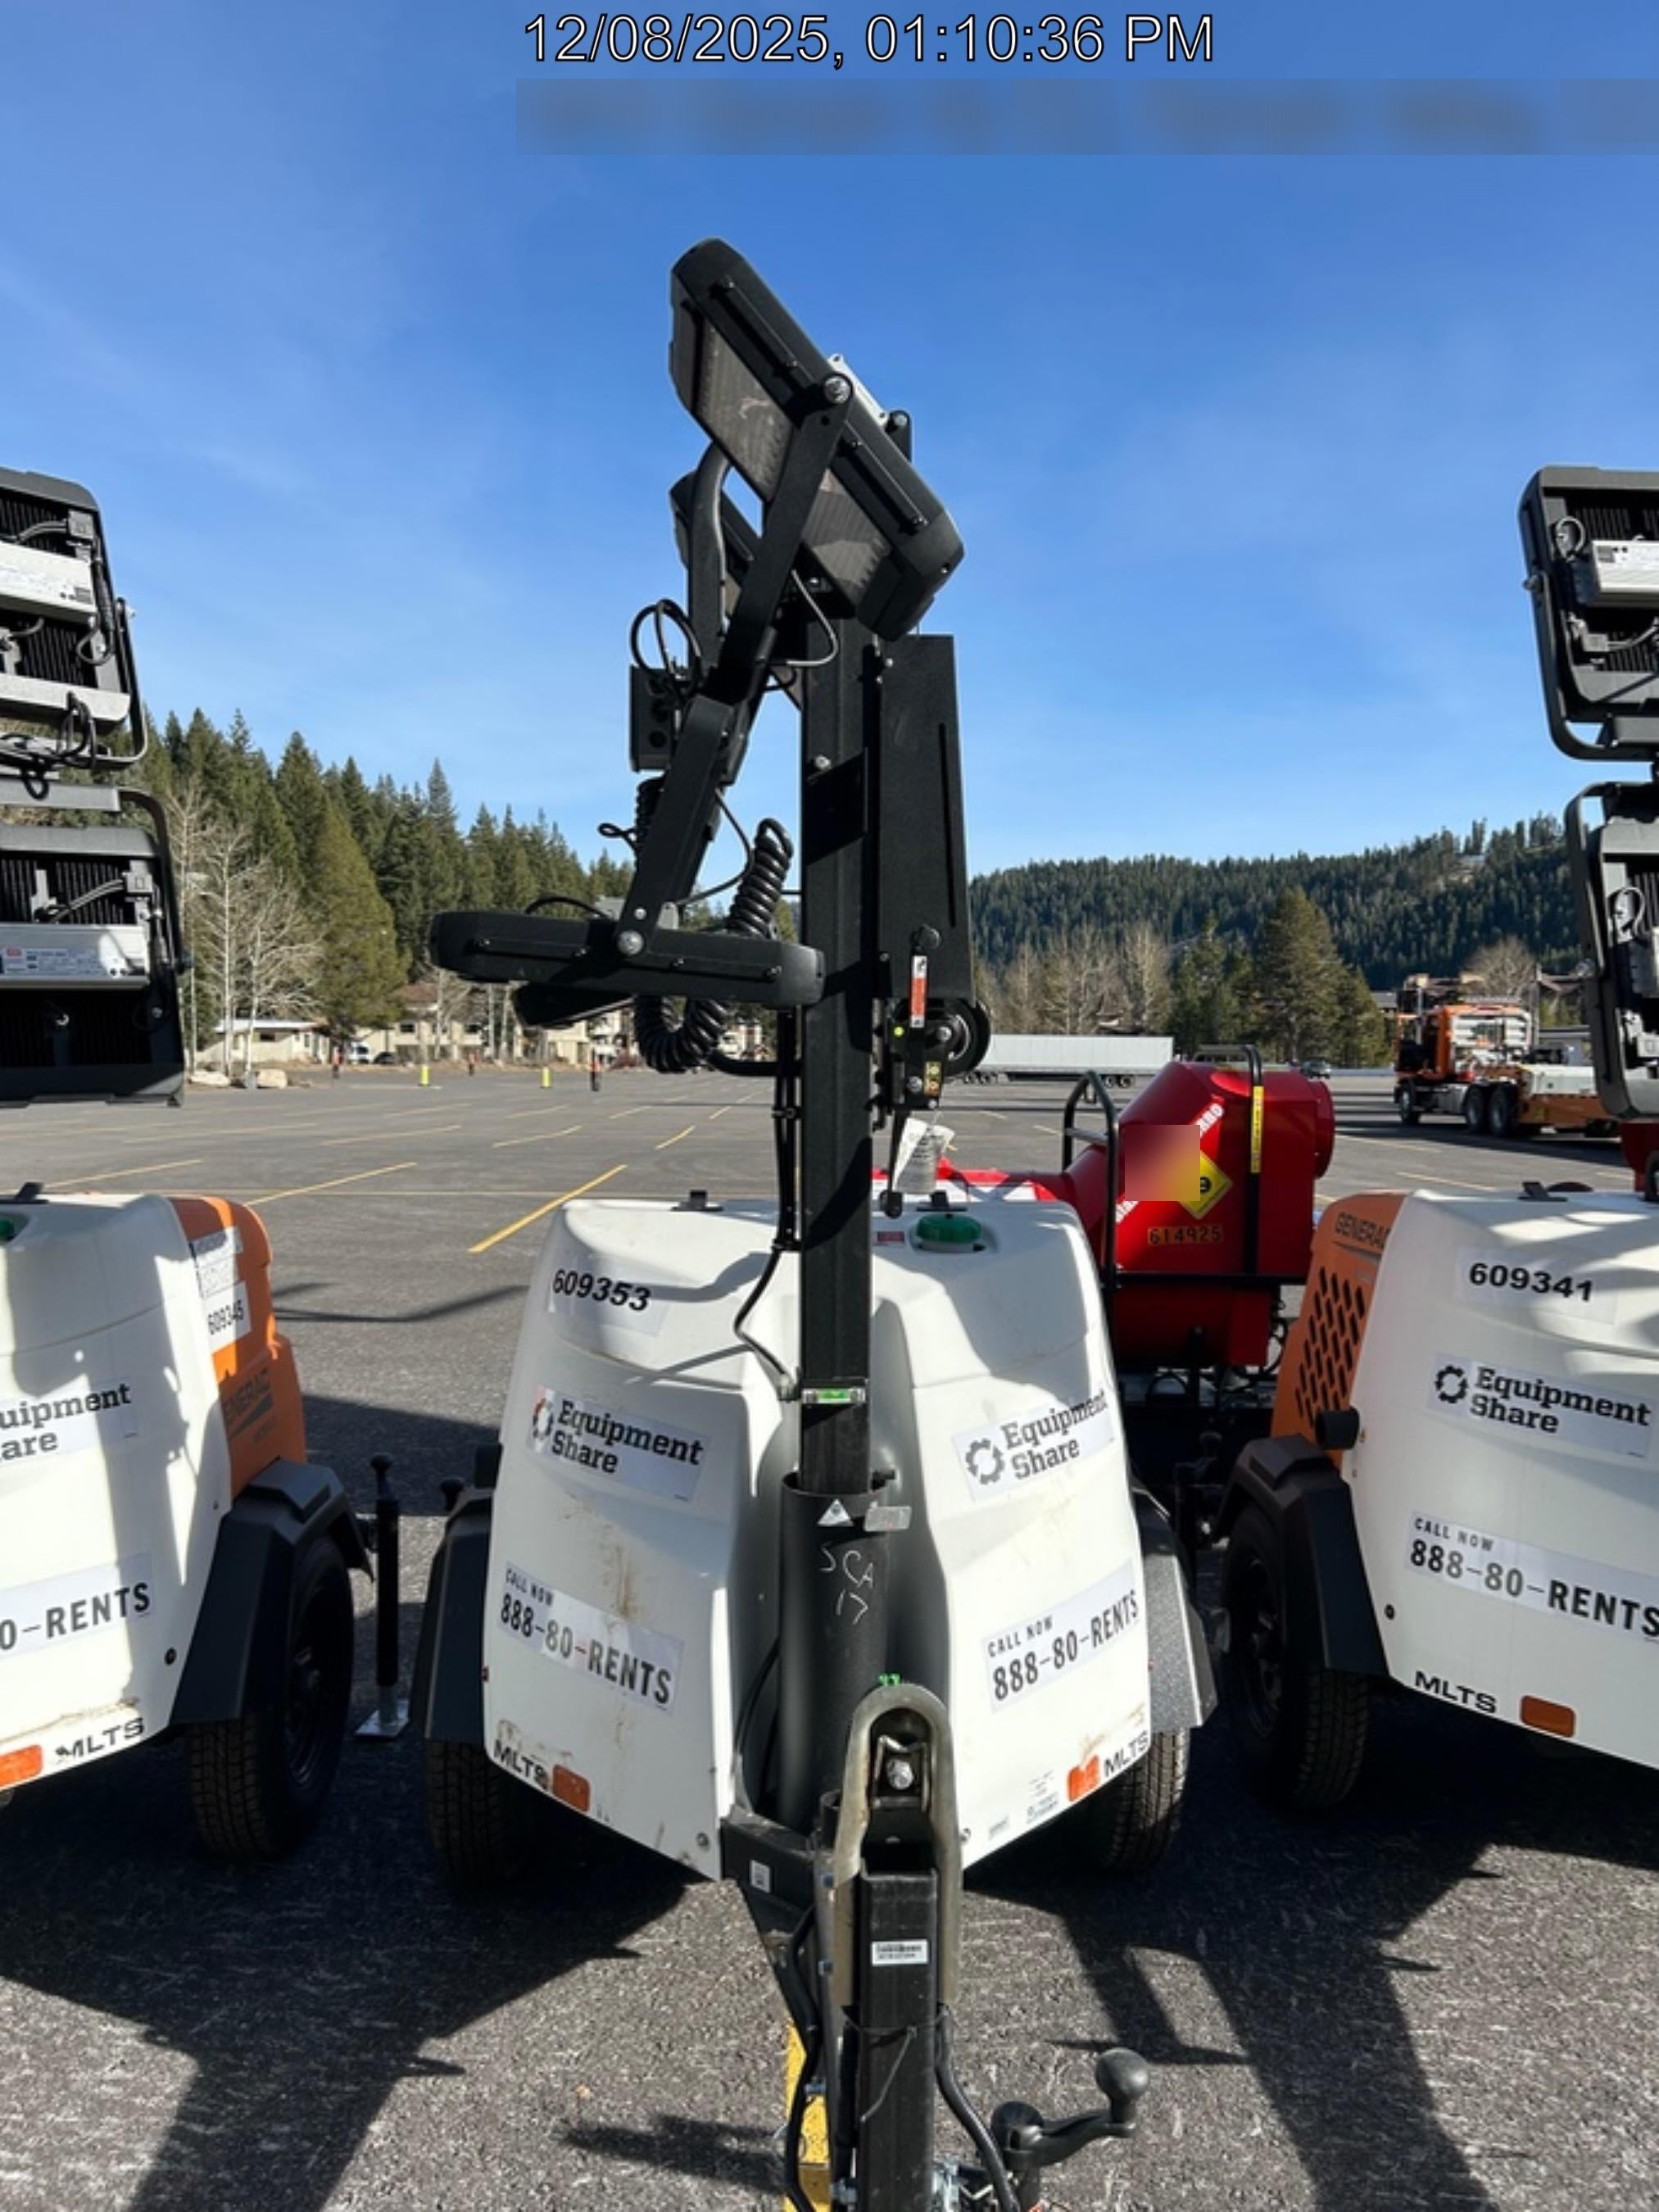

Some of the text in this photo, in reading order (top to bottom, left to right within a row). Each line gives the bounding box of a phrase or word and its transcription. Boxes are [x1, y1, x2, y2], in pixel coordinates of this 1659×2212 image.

[552, 1269, 652, 1312] 609353
[1469, 1262, 1593, 1302] 609341
[1470, 1395, 1560, 1434] Share
[1475, 1367, 1652, 1426] Equipment
[558, 1399, 704, 1466] Equipment
[999, 1389, 1108, 1450] Equipment
[0, 1432, 58, 1461] are
[552, 1430, 619, 1473] Share
[1010, 1439, 1081, 1480] Share
[1414, 1517, 1494, 1552] CALL NOW
[505, 1567, 554, 1607] CALL NOW
[1410, 1539, 1659, 1638] 888-80-RENTS
[501, 1593, 672, 1705] 888-80-RENTS
[988, 1614, 1054, 1657] CALL NOW
[993, 1589, 1138, 1701] 888-80-RENTS
[1415, 1670, 1498, 1714] MLTS
[55, 1717, 145, 1760] MLTS
[1103, 1729, 1149, 1778] MLTS
[493, 1739, 550, 1791] MLTS
